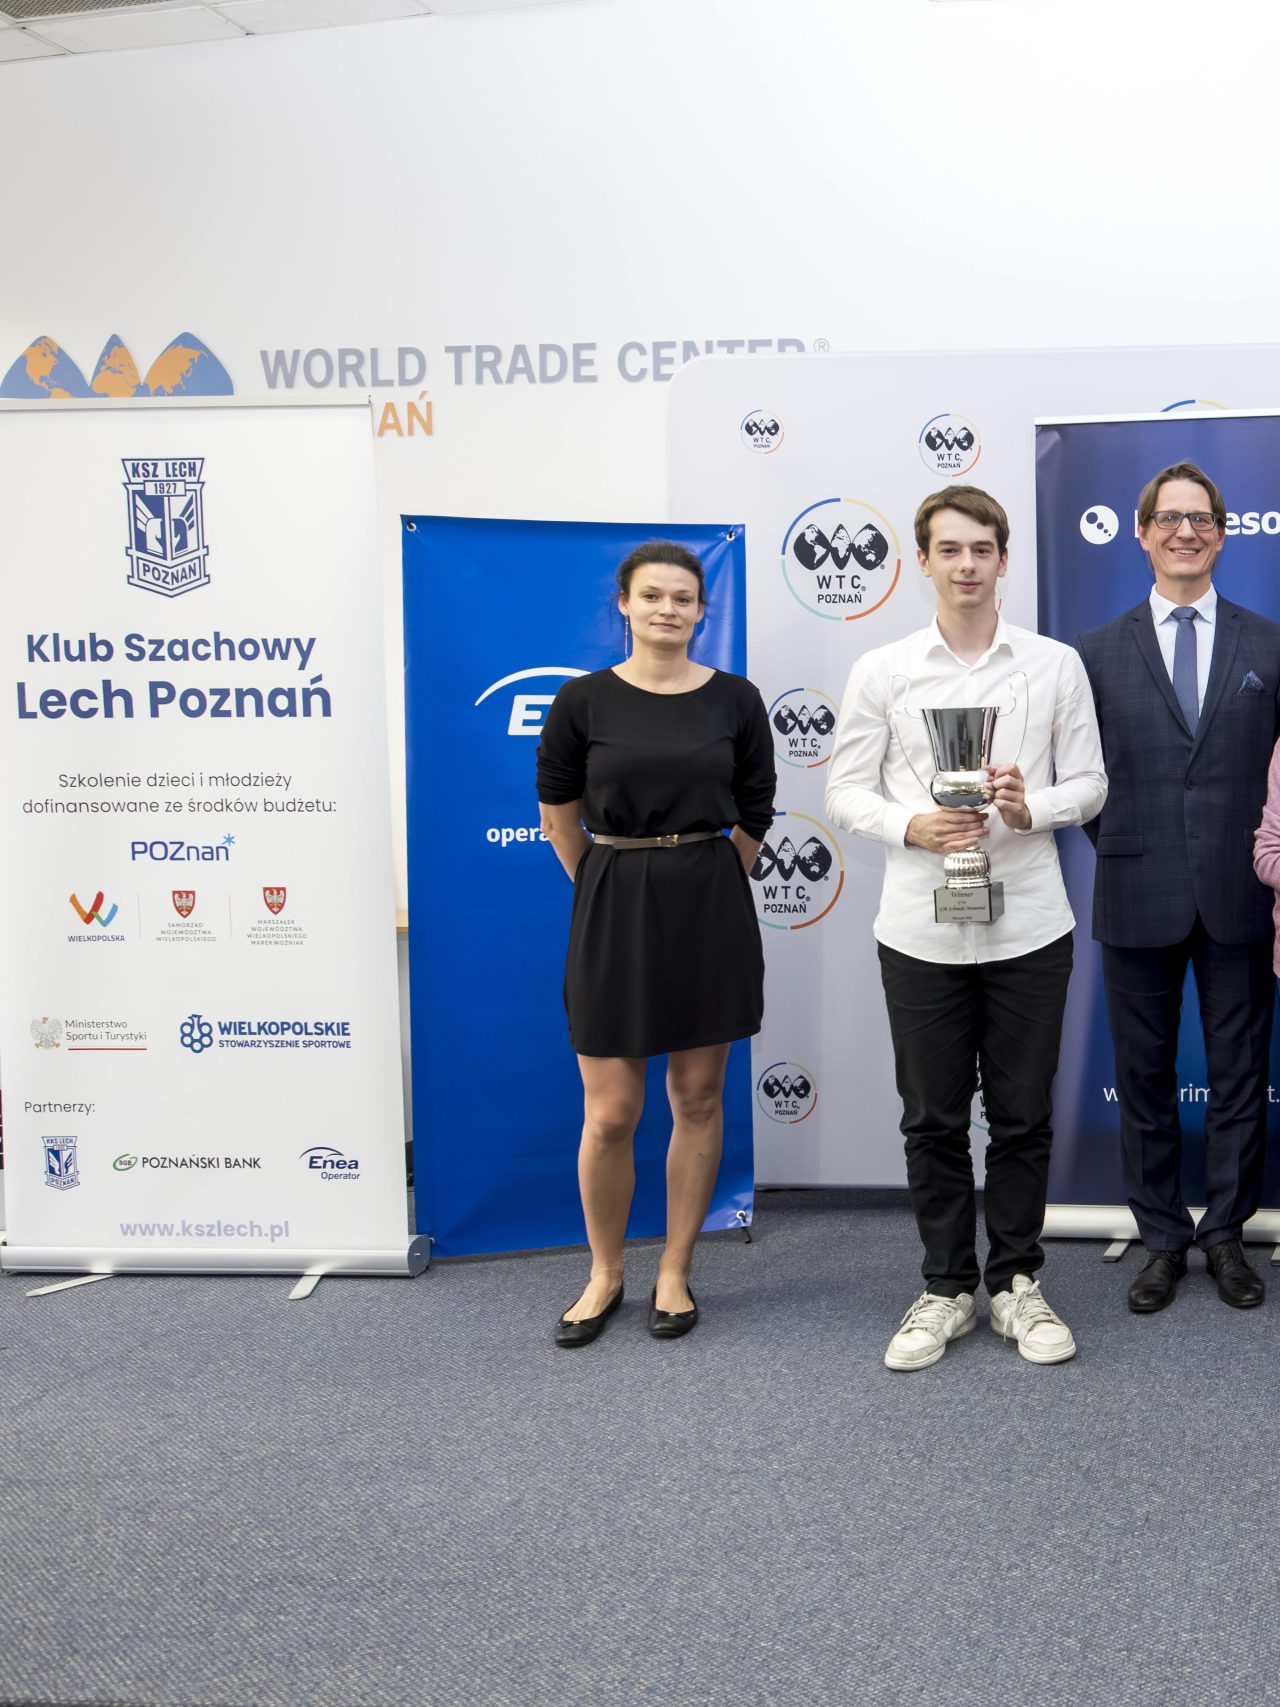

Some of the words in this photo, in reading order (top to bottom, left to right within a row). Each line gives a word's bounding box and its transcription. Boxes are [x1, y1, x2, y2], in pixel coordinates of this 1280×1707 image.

[260, 347, 427, 389] WORLD
[445, 343, 598, 385] TRADE
[131, 462, 159, 478] KSZ
[165, 462, 197, 478] LECH
[153, 482, 177, 495] 1927
[142, 560, 197, 585] POZNAŃ
[817, 591, 862, 604] POZNAŃ
[27, 633, 114, 663] Klub
[125, 631, 316, 671] Szachowy
[17, 680, 133, 719] Lech
[149, 674, 332, 718] Poznań
[789, 749, 818, 757] POZNAŃ
[58, 773, 141, 788] Szkolenie
[147, 772, 195, 788] dzieci
[209, 772, 292, 791] młodzieży
[22, 799, 159, 814] dofinansowane
[164, 800, 182, 813] ze
[188, 798, 257, 813] środków
[263, 798, 336, 813] budżetu:
[764, 901, 807, 914] POZNAŃ
[67, 934, 125, 942] WIELKOPOLSKA
[65, 1020, 128, 1029] Ministerstwo
[218, 1021, 351, 1037] WIELKOPOLSKIE
[66, 1032, 98, 1043] Sportu
[105, 1031, 147, 1043] Turystyki
[219, 1040, 300, 1049] STOWARZYSZENIE
[302, 1040, 352, 1049] SPORTOWE
[24, 1101, 95, 1115] Partnerzy:
[142, 1153, 220, 1169] POZNAŃSKI
[225, 1157, 262, 1169] BANK
[308, 1156, 359, 1170] Enea
[320, 1171, 361, 1181] Operator
[120, 1220, 290, 1243] www.kszlech.pl
